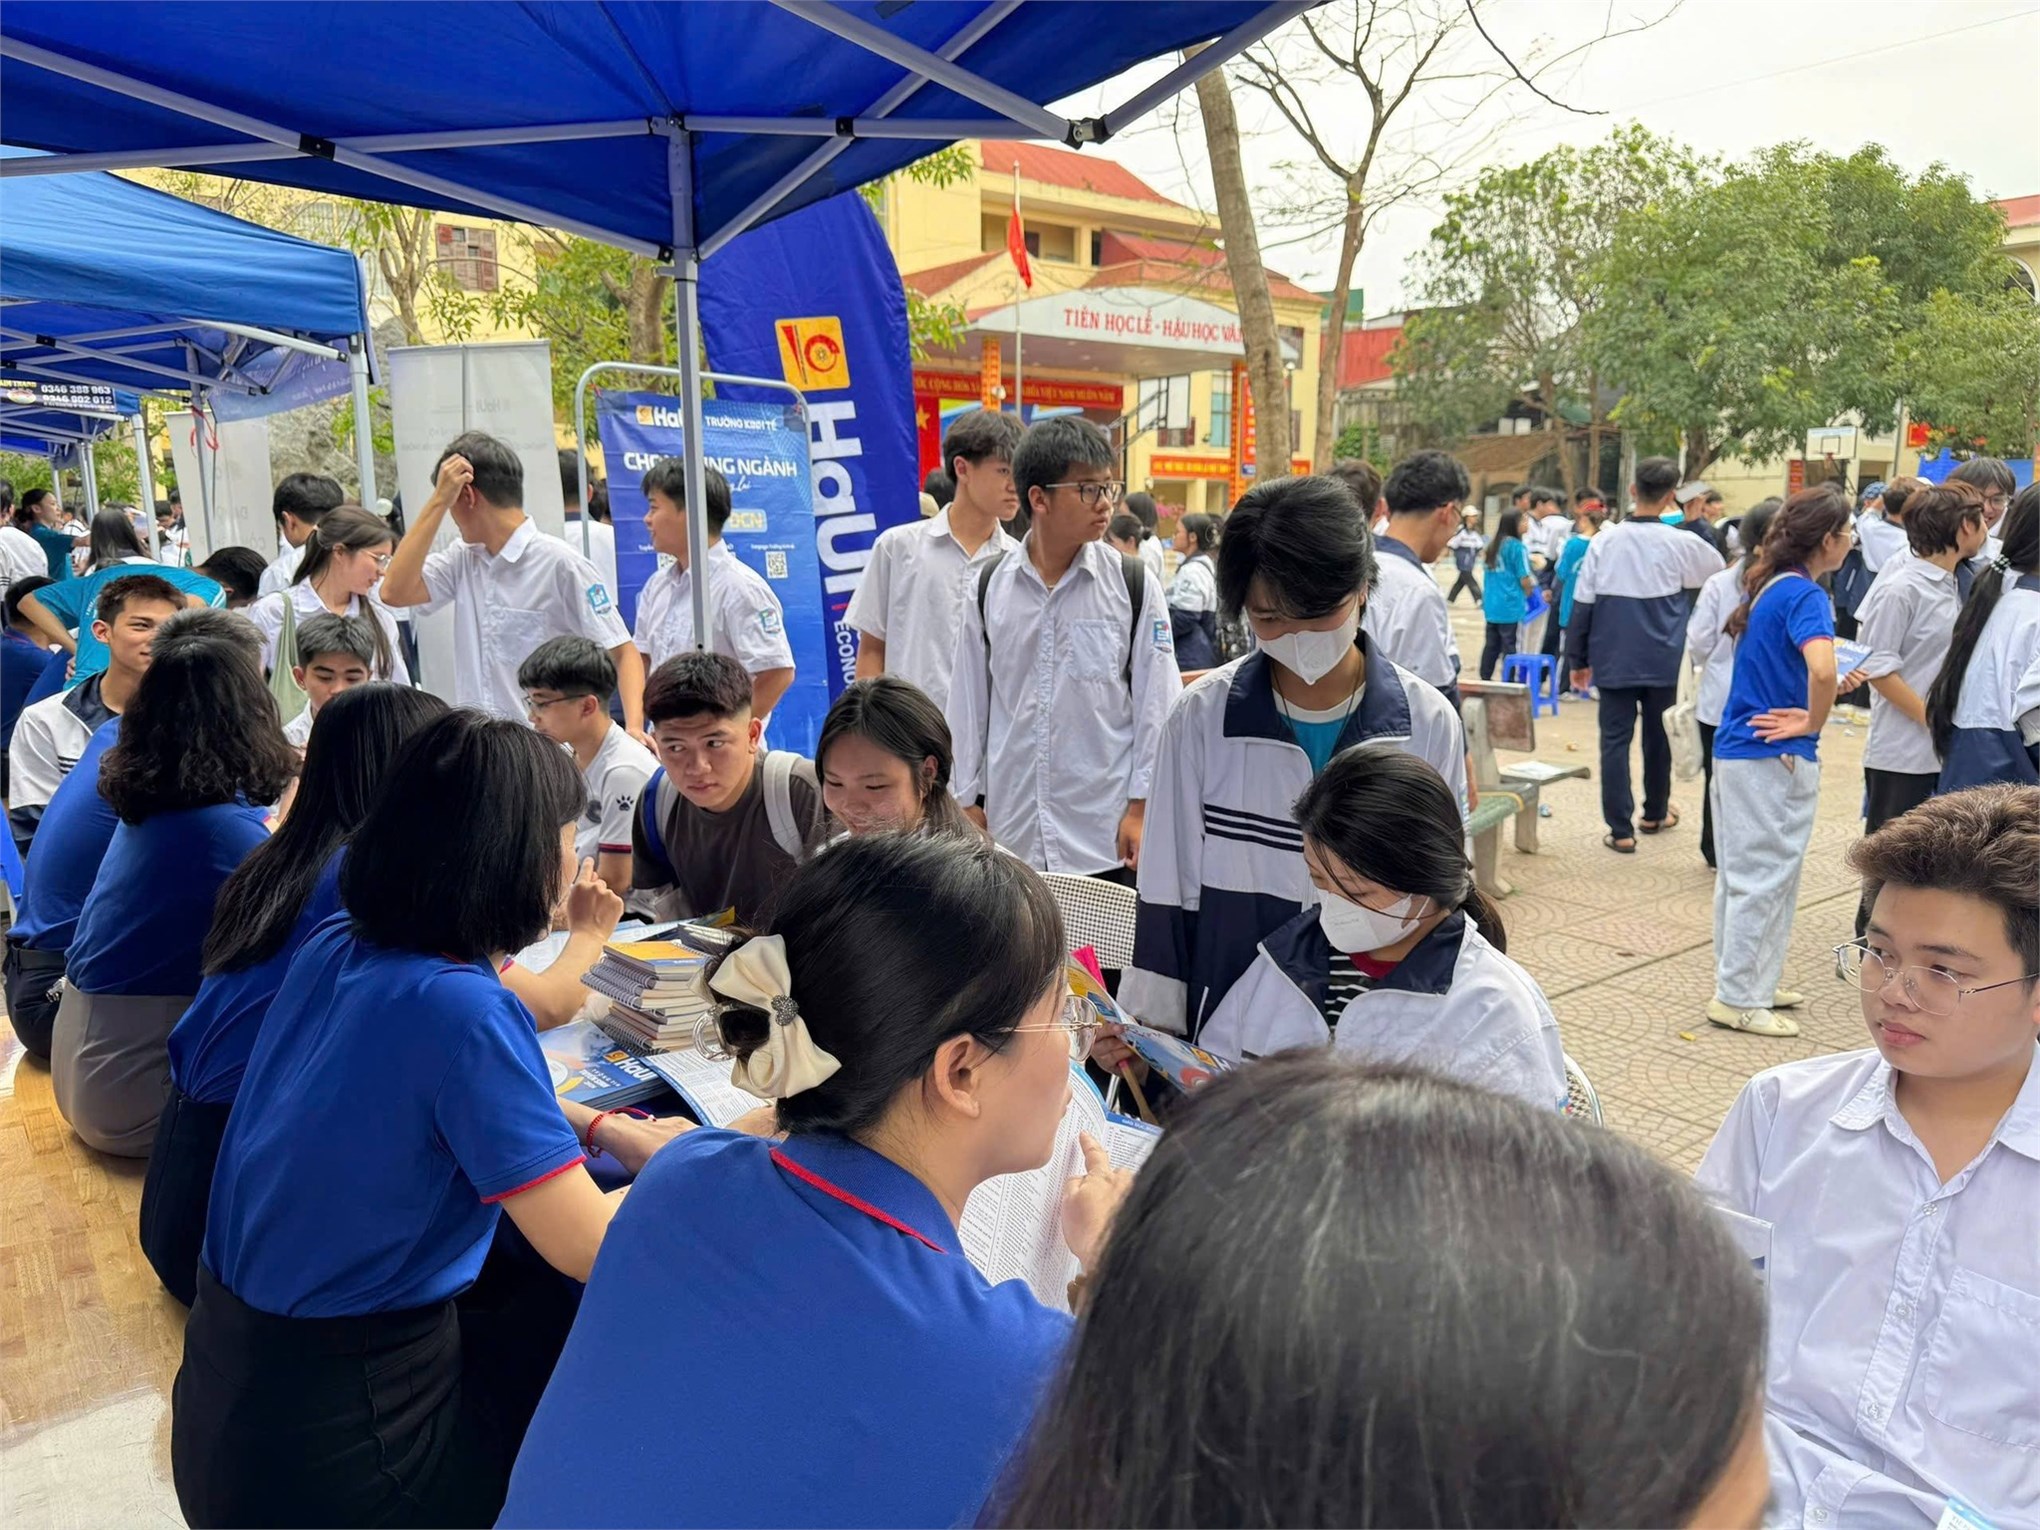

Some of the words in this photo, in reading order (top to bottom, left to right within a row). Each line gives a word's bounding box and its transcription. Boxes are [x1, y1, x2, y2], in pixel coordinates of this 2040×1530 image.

[1105, 313, 1135, 336] HỌC
[1192, 323, 1218, 344] HỌC
[737, 455, 797, 477] NGÀNH
[614, 1057, 659, 1081] HaUI
